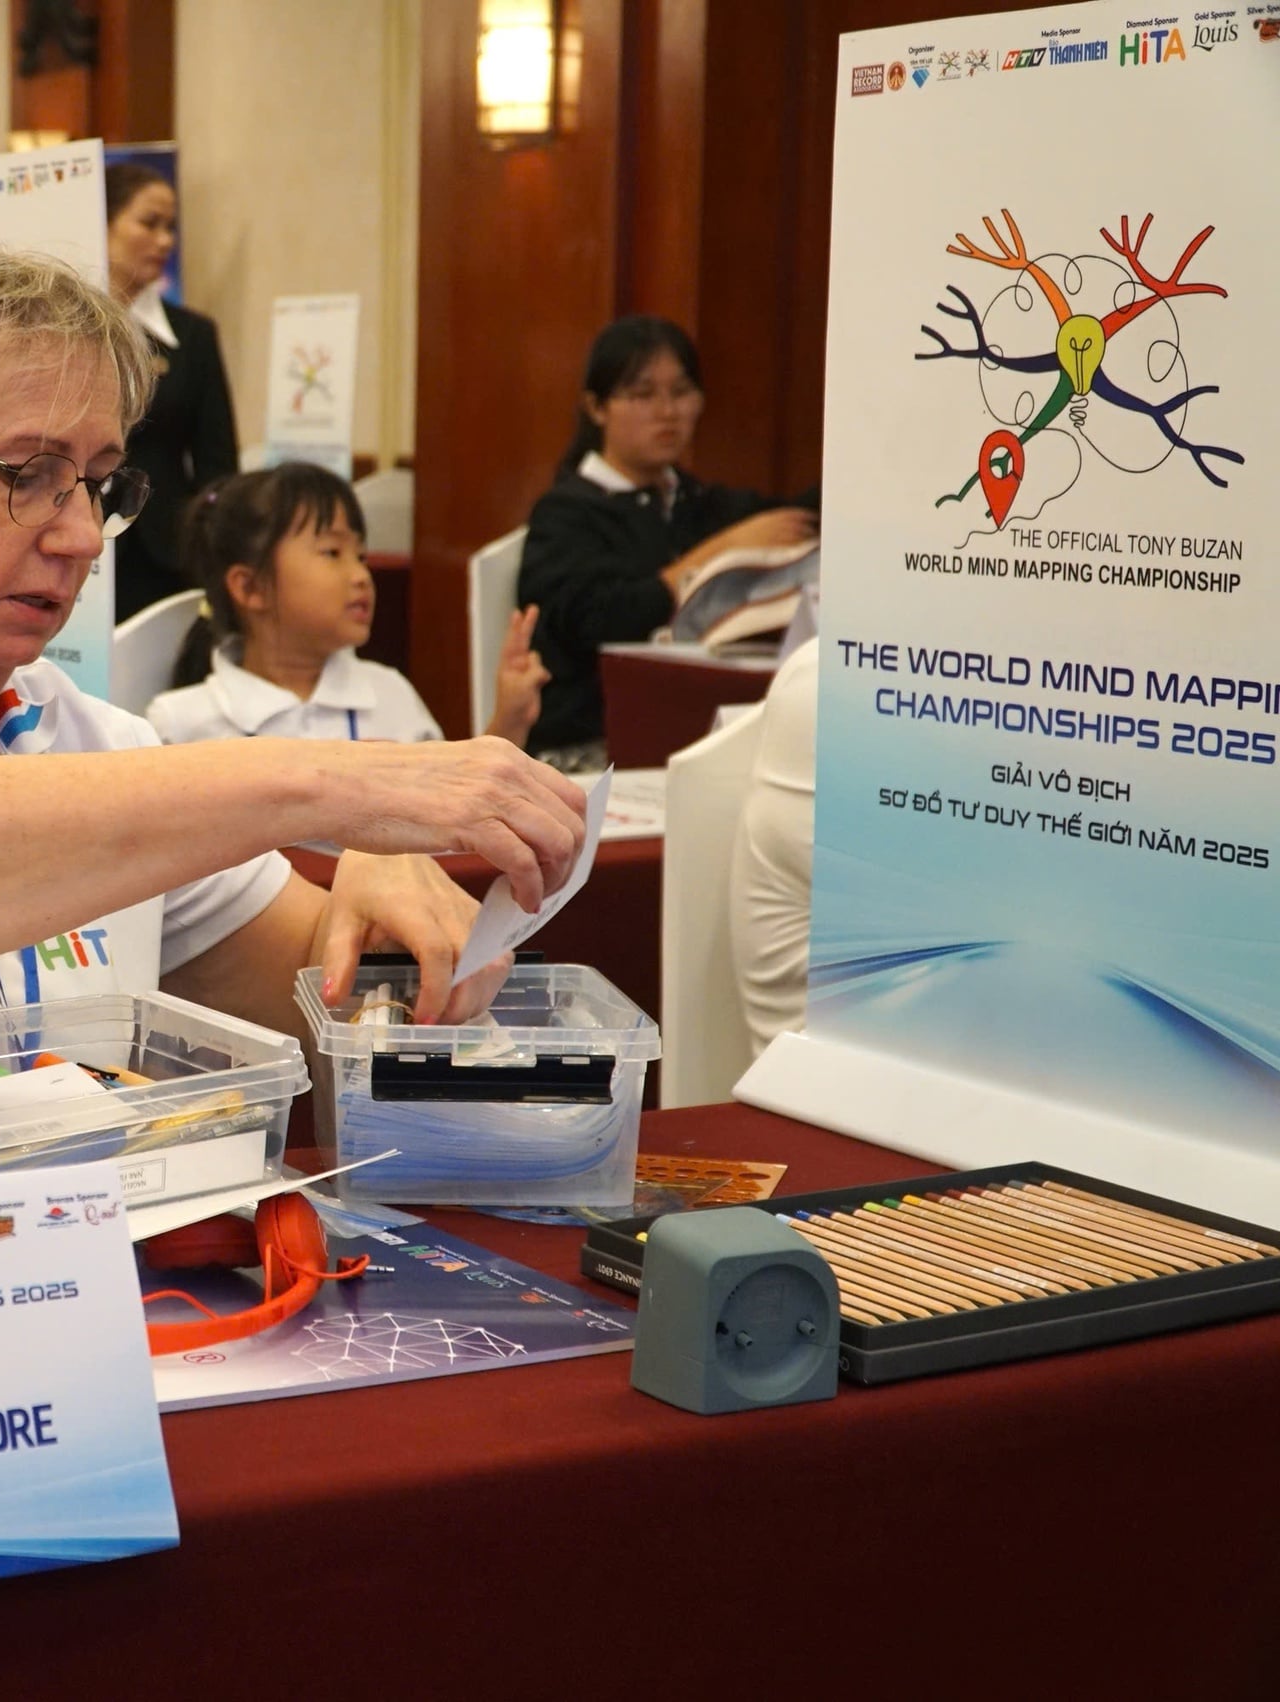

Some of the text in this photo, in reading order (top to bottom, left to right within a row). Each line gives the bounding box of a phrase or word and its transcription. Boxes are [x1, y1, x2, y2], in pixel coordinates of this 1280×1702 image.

[1126, 17, 1179, 29] Diamond Sponsor
[1192, 19, 1239, 52] Louis
[1003, 48, 1047, 71] HTV
[1120, 28, 1186, 67] HiTA
[853, 75, 882, 87] RECORD
[854, 66, 882, 78] VIETNAM
[1010, 528, 1243, 560] THE OFFICIAL TONY BUZAN
[905, 552, 1241, 593] WORLD MIND MAPPING CHAMPIONSHIP
[838, 639, 899, 672] THE
[908, 646, 1031, 686] WORLD
[1042, 660, 1135, 698] MIND
[875, 688, 1276, 765] CHAMPIONSHIPS 2025
[991, 761, 1131, 803] GIẢI VÔ ĐỊCH
[879, 787, 909, 808] SƠ
[948, 798, 980, 820] TƯ
[985, 804, 1030, 829] DUY
[1037, 811, 1082, 838] THẾ
[1088, 820, 1132, 846] GIỚI
[1138, 827, 1196, 857] NĂM
[1202, 839, 1270, 869] 2025
[35, 928, 110, 972] HiT
[12, 1281, 79, 1304] 2025
